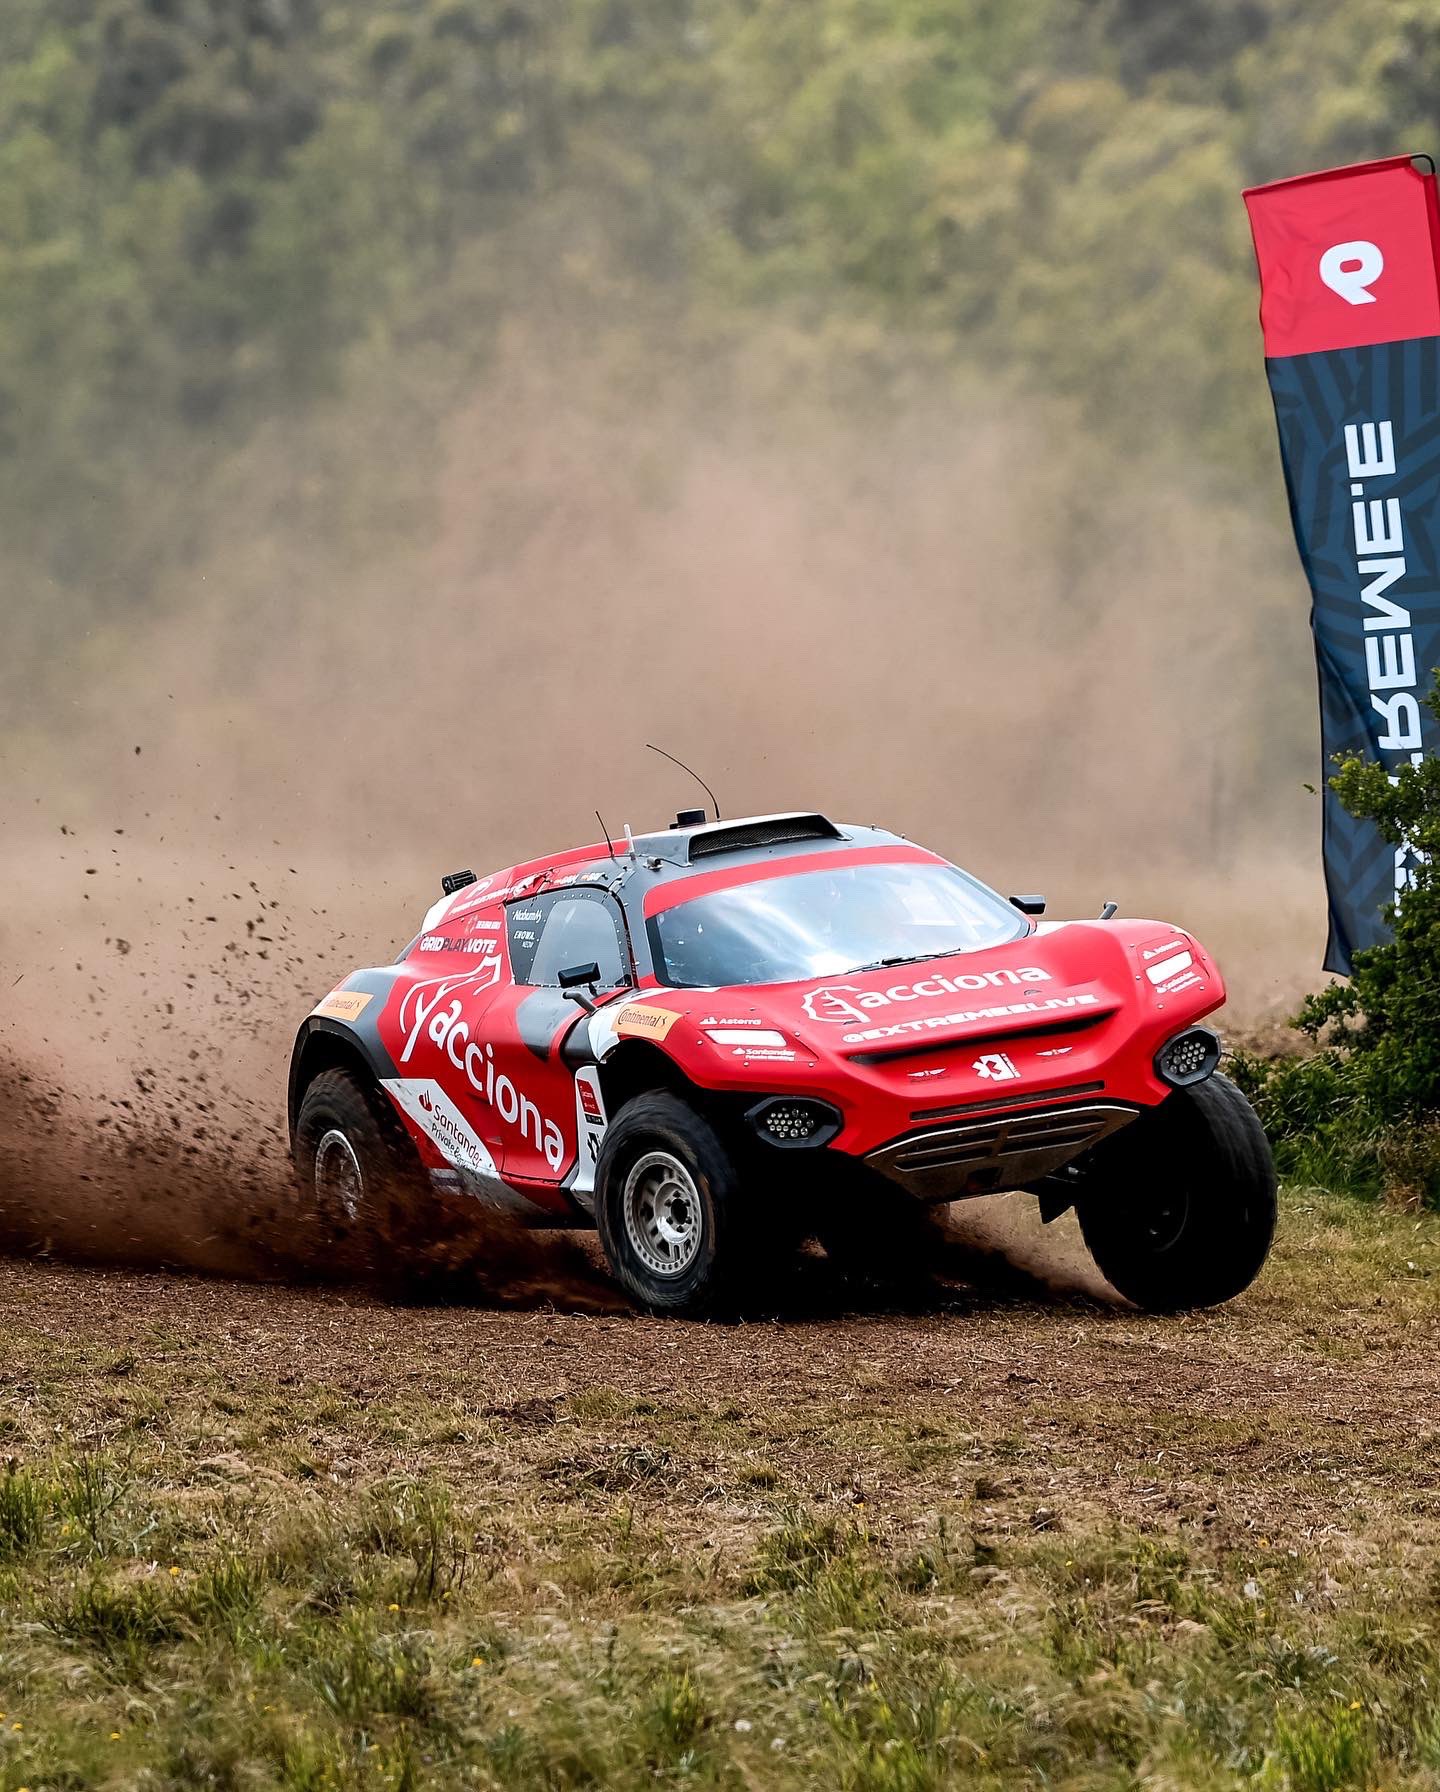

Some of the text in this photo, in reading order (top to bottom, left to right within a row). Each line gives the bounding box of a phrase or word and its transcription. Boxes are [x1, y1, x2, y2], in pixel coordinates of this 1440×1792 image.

[856, 966, 1053, 1009] acciona
[618, 1009, 662, 1027] Continental
[745, 1048, 796, 1057] Santander
[428, 999, 565, 1173] acciona
[433, 1104, 482, 1170] Santander
